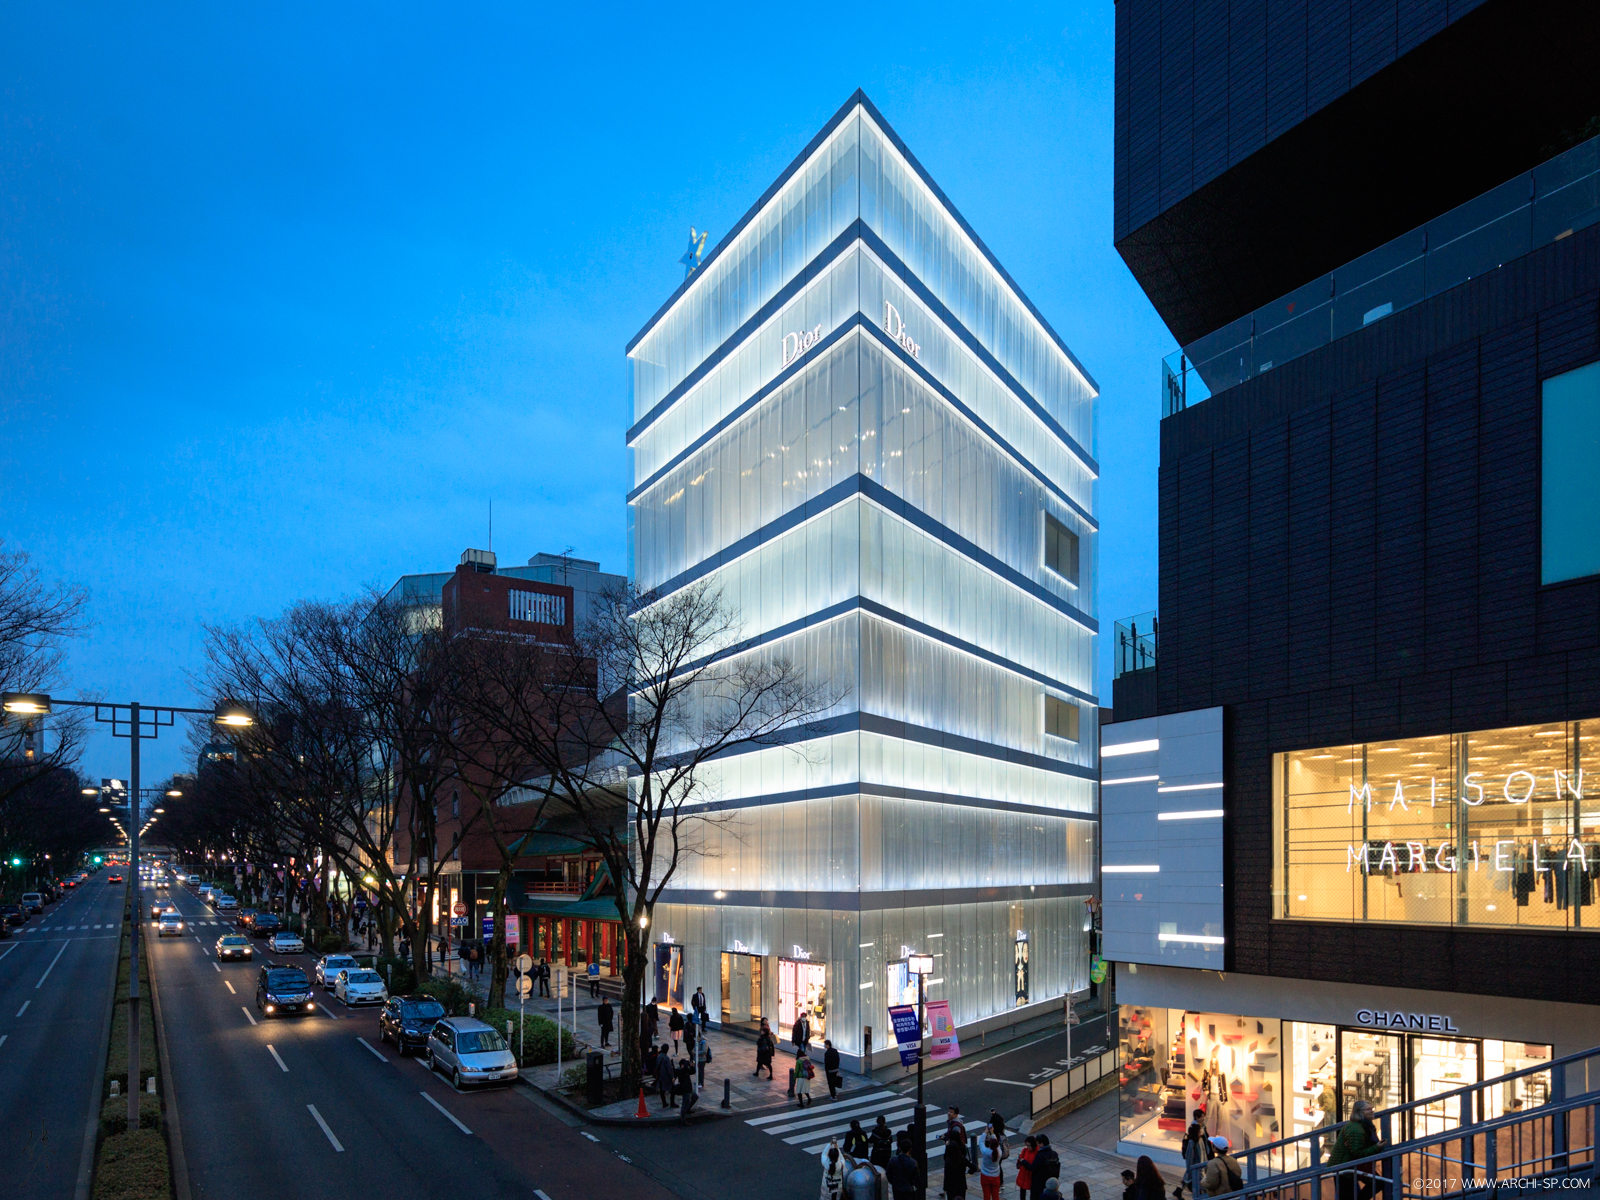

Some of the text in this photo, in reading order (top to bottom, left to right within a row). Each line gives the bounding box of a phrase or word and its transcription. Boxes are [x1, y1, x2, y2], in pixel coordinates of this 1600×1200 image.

[884, 300, 921, 359] Dior
[781, 323, 822, 369] Dior
[1347, 768, 1584, 814] MAISON
[1346, 839, 1587, 873] MARGIELA
[663, 932, 675, 944] Dior
[734, 940, 749, 953] Dior
[1016, 930, 1027, 940] Dior
[793, 944, 811, 960] Dior
[1356, 1009, 1458, 1032] CHANEL
